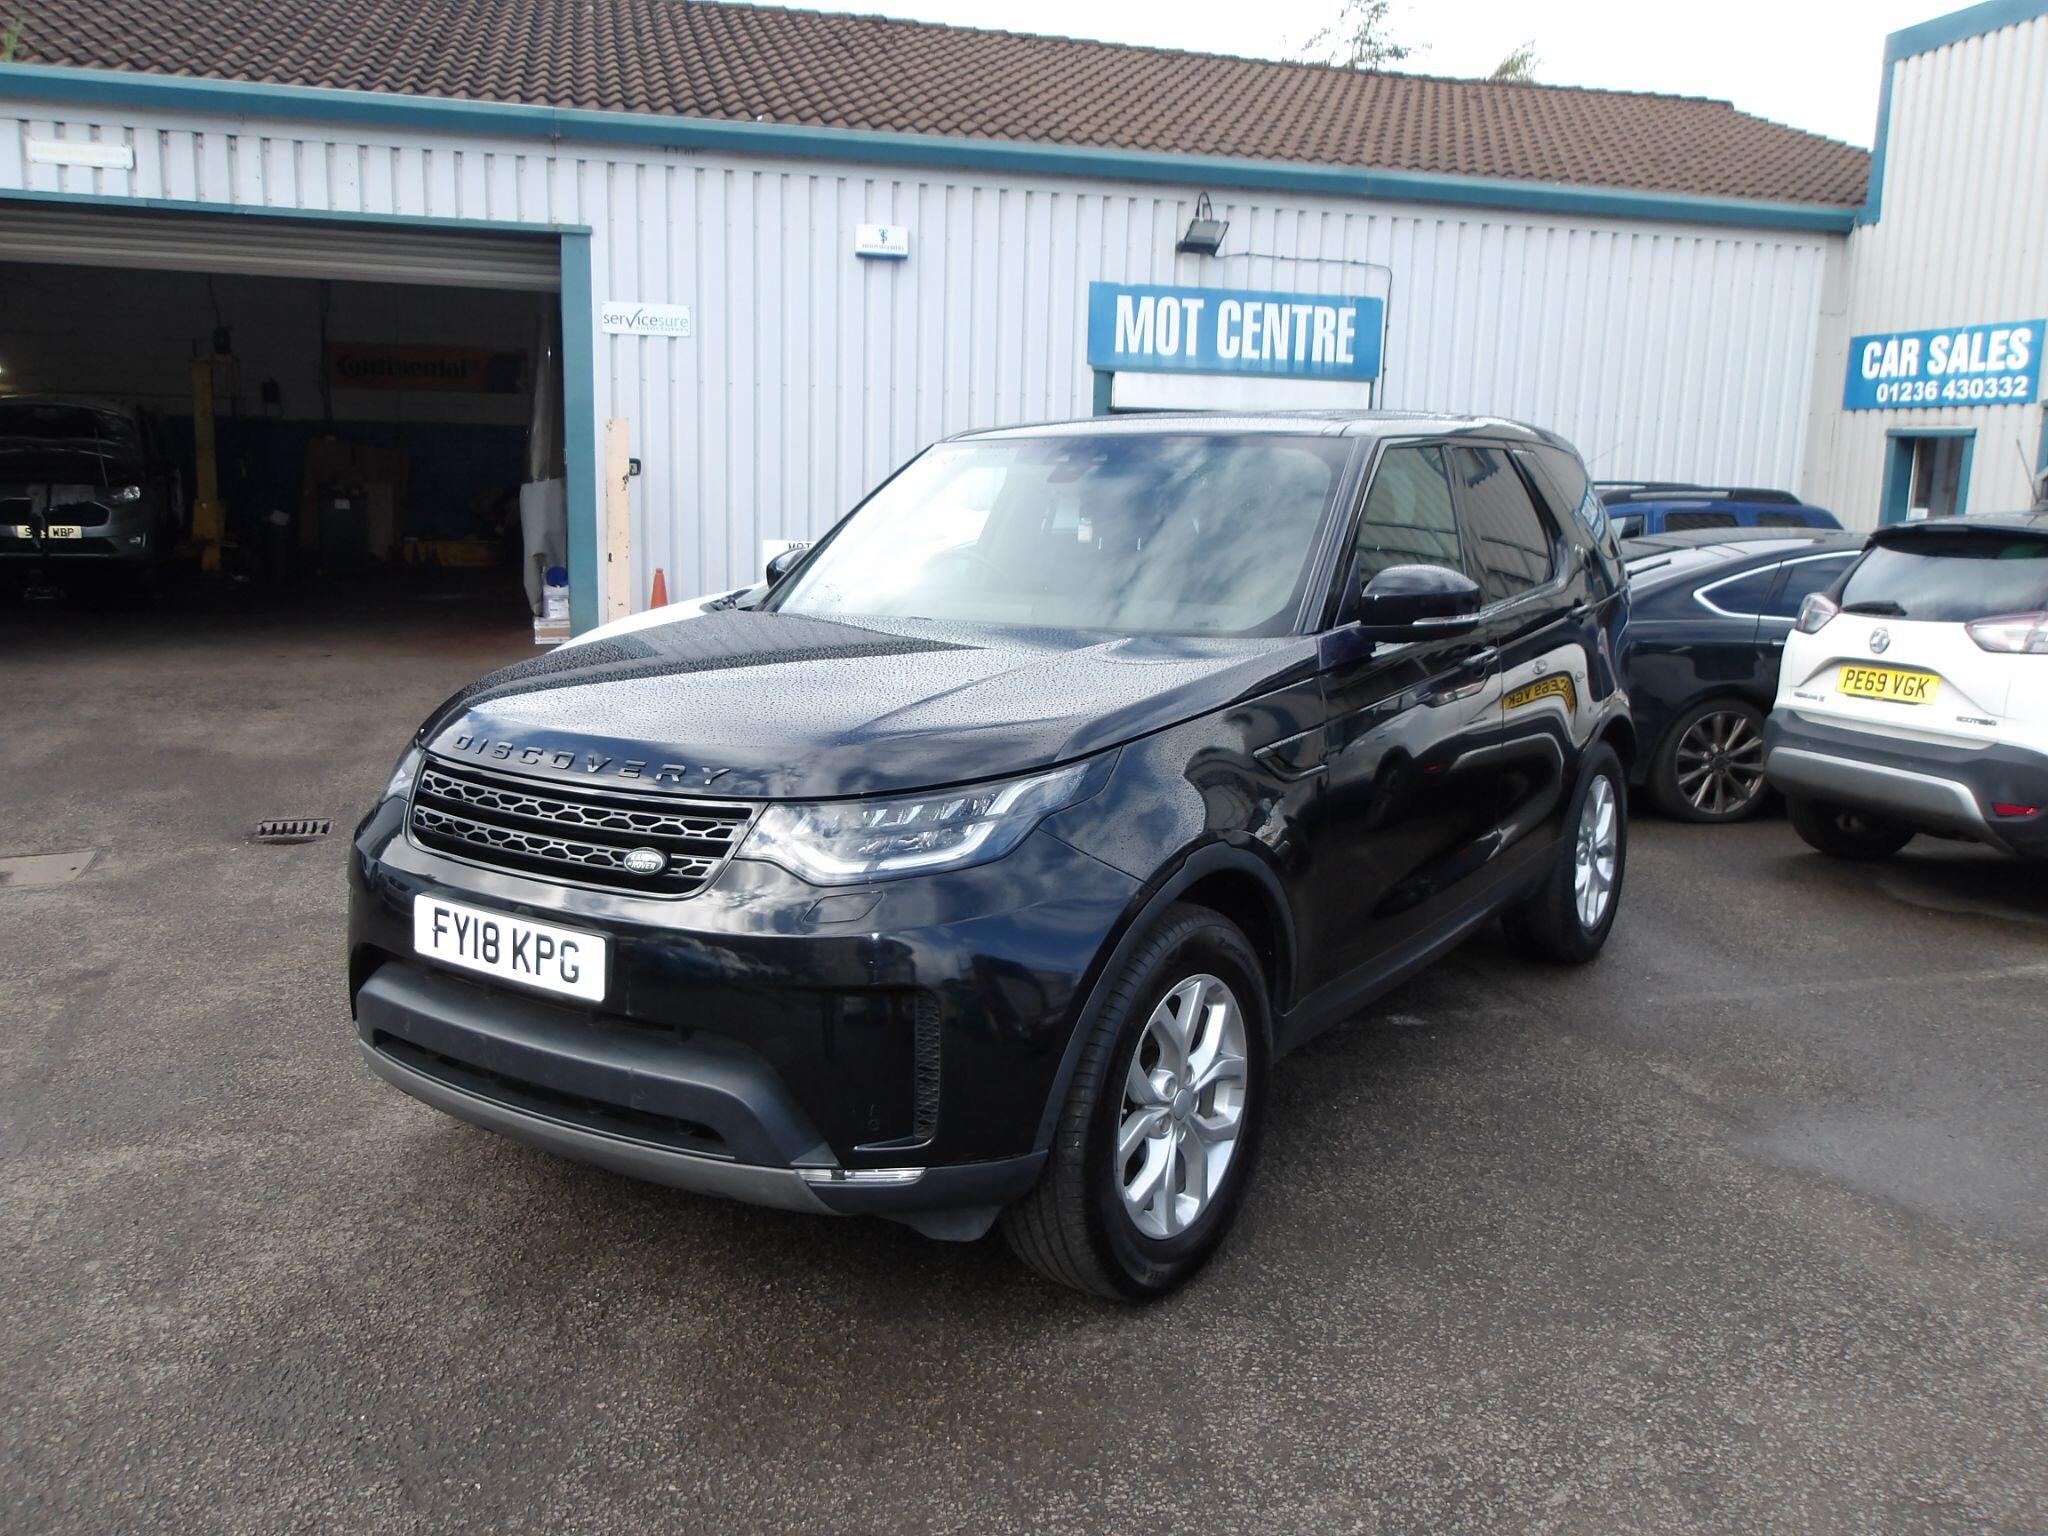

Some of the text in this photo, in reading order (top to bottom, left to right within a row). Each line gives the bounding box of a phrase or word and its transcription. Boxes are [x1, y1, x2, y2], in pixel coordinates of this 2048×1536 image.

[603, 308, 688, 328] servicesure
[1115, 295, 1356, 363] MOT CENTRE
[336, 352, 464, 377] Continental
[1862, 328, 2031, 379] CAR SALES
[1876, 375, 2028, 403] 01236 430332
[52, 527, 74, 537] WBP
[1843, 669, 1930, 698] PE69 VGK
[452, 734, 731, 785] DISCOVERY
[630, 861, 656, 870] ROVER
[432, 907, 580, 984] FY18 KPG
